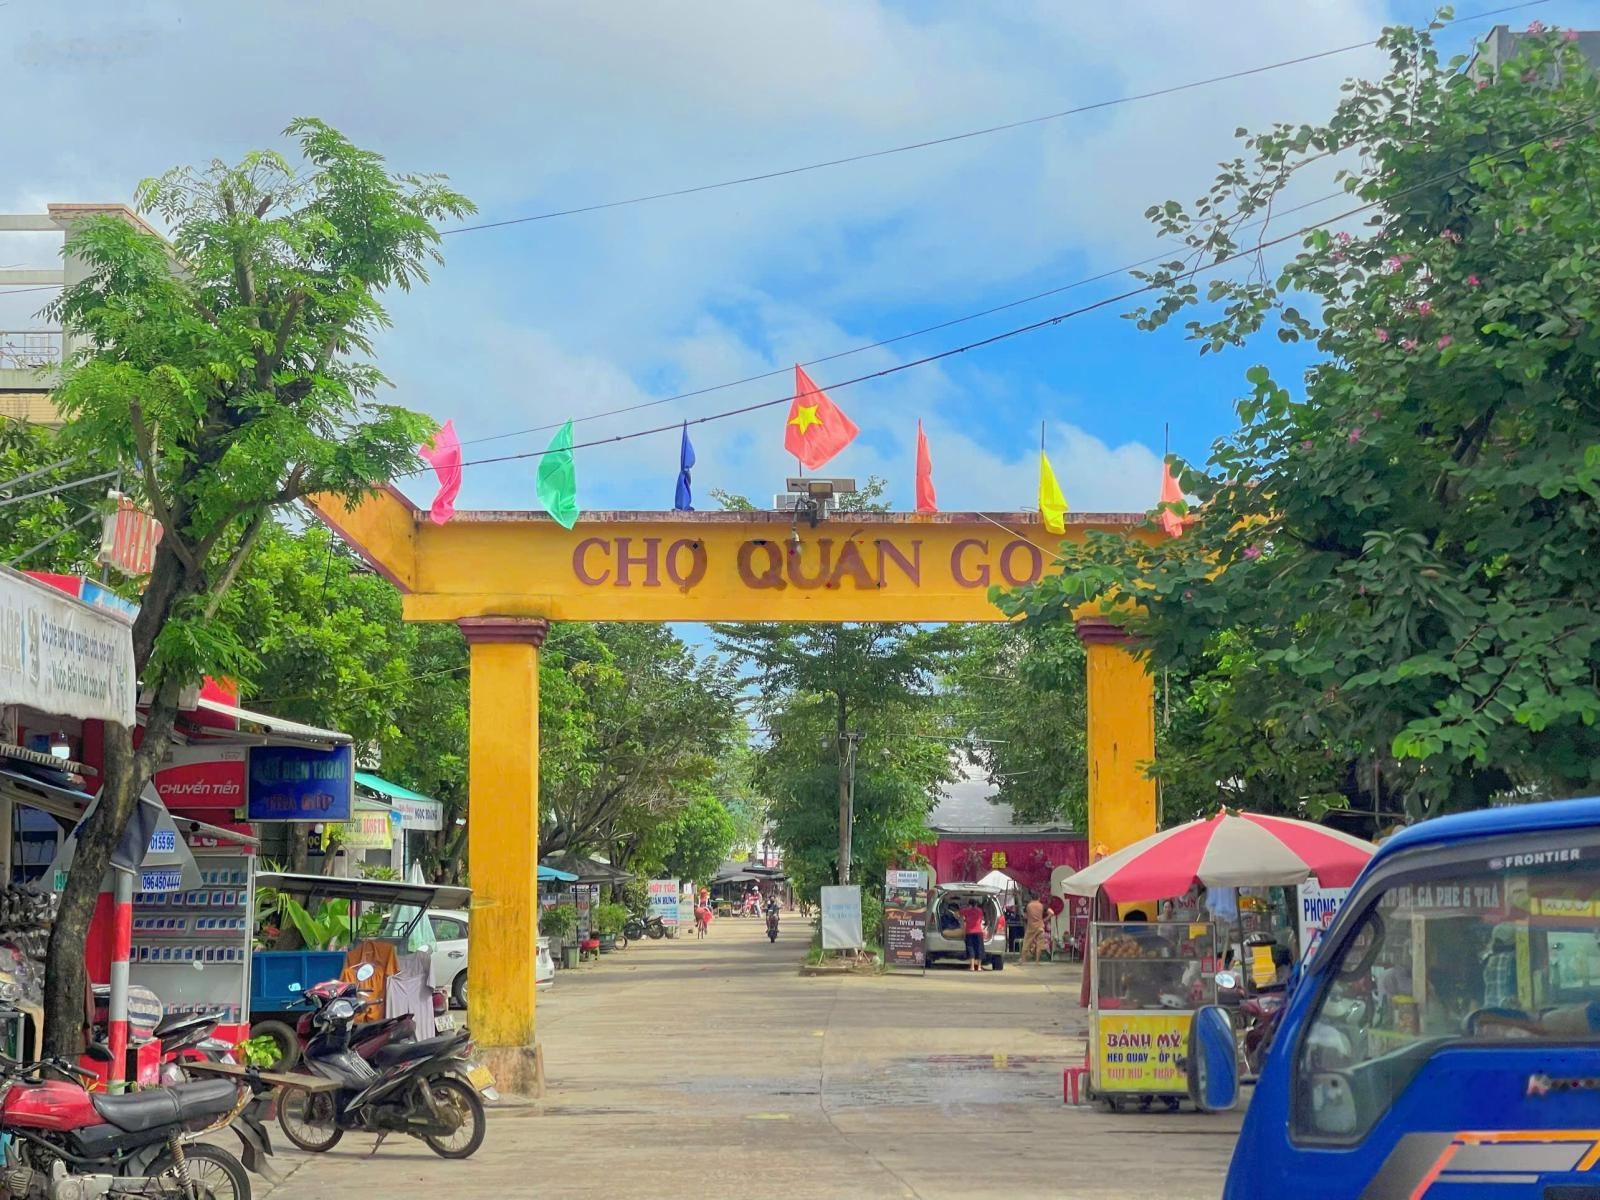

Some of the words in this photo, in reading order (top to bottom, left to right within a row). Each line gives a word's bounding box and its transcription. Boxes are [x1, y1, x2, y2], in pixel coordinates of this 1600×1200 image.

[737, 528, 923, 590] QUÁN
[1505, 849, 1580, 868] FRONTIER
[1107, 1053, 1123, 1063] HEO
[1126, 1053, 1148, 1063] QUAY
